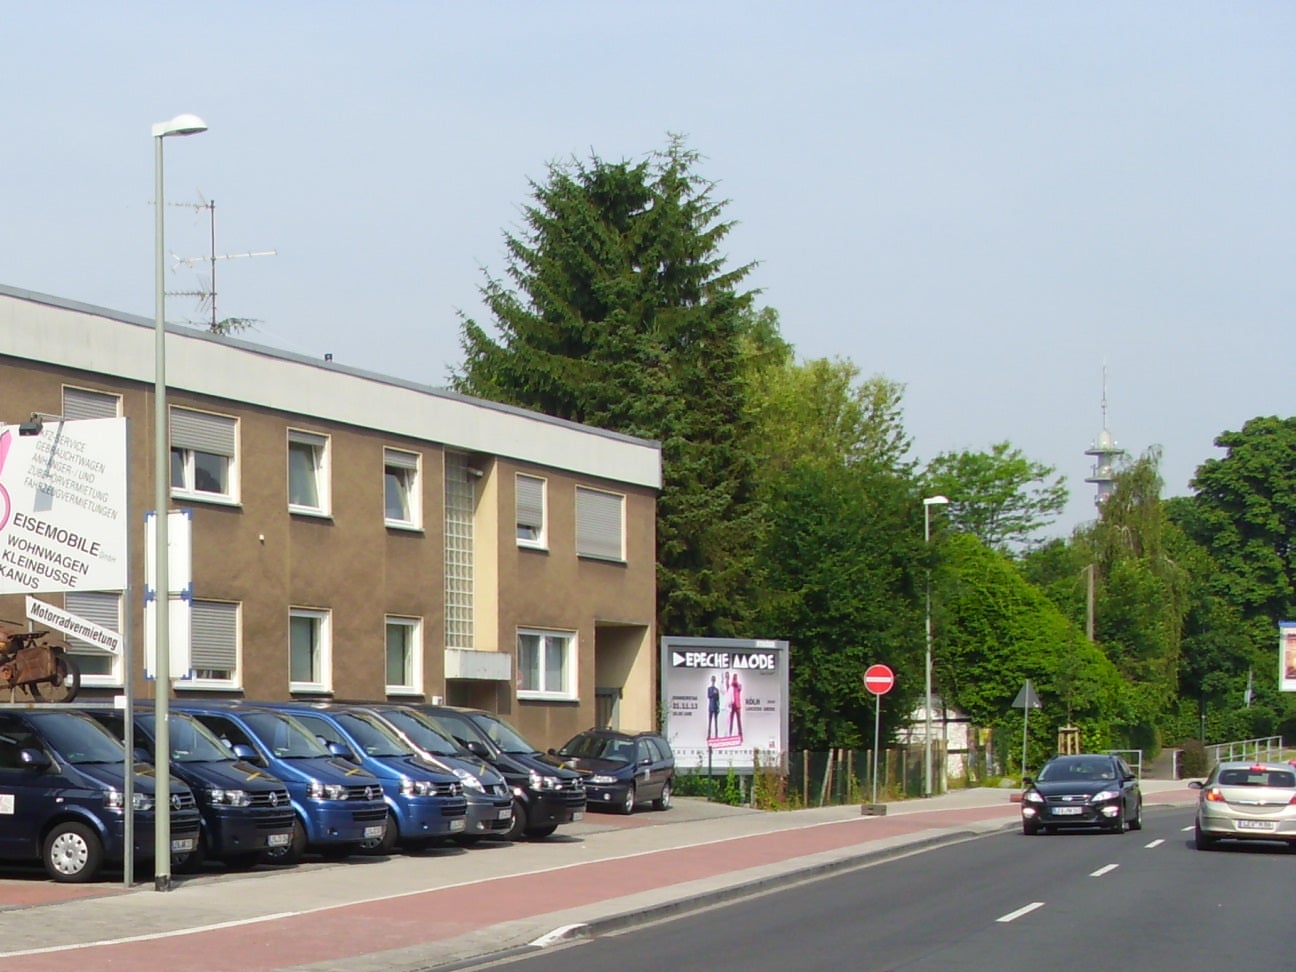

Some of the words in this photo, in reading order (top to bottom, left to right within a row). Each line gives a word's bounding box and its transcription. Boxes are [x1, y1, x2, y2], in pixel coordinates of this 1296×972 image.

[7, 534, 89, 575] WOHNWAGEN
[13, 512, 101, 557] EISEMOBILE
[2, 549, 78, 588] KLEINBUSSE
[30, 602, 119, 651] Motorradvermietung
[733, 654, 775, 669] MODE
